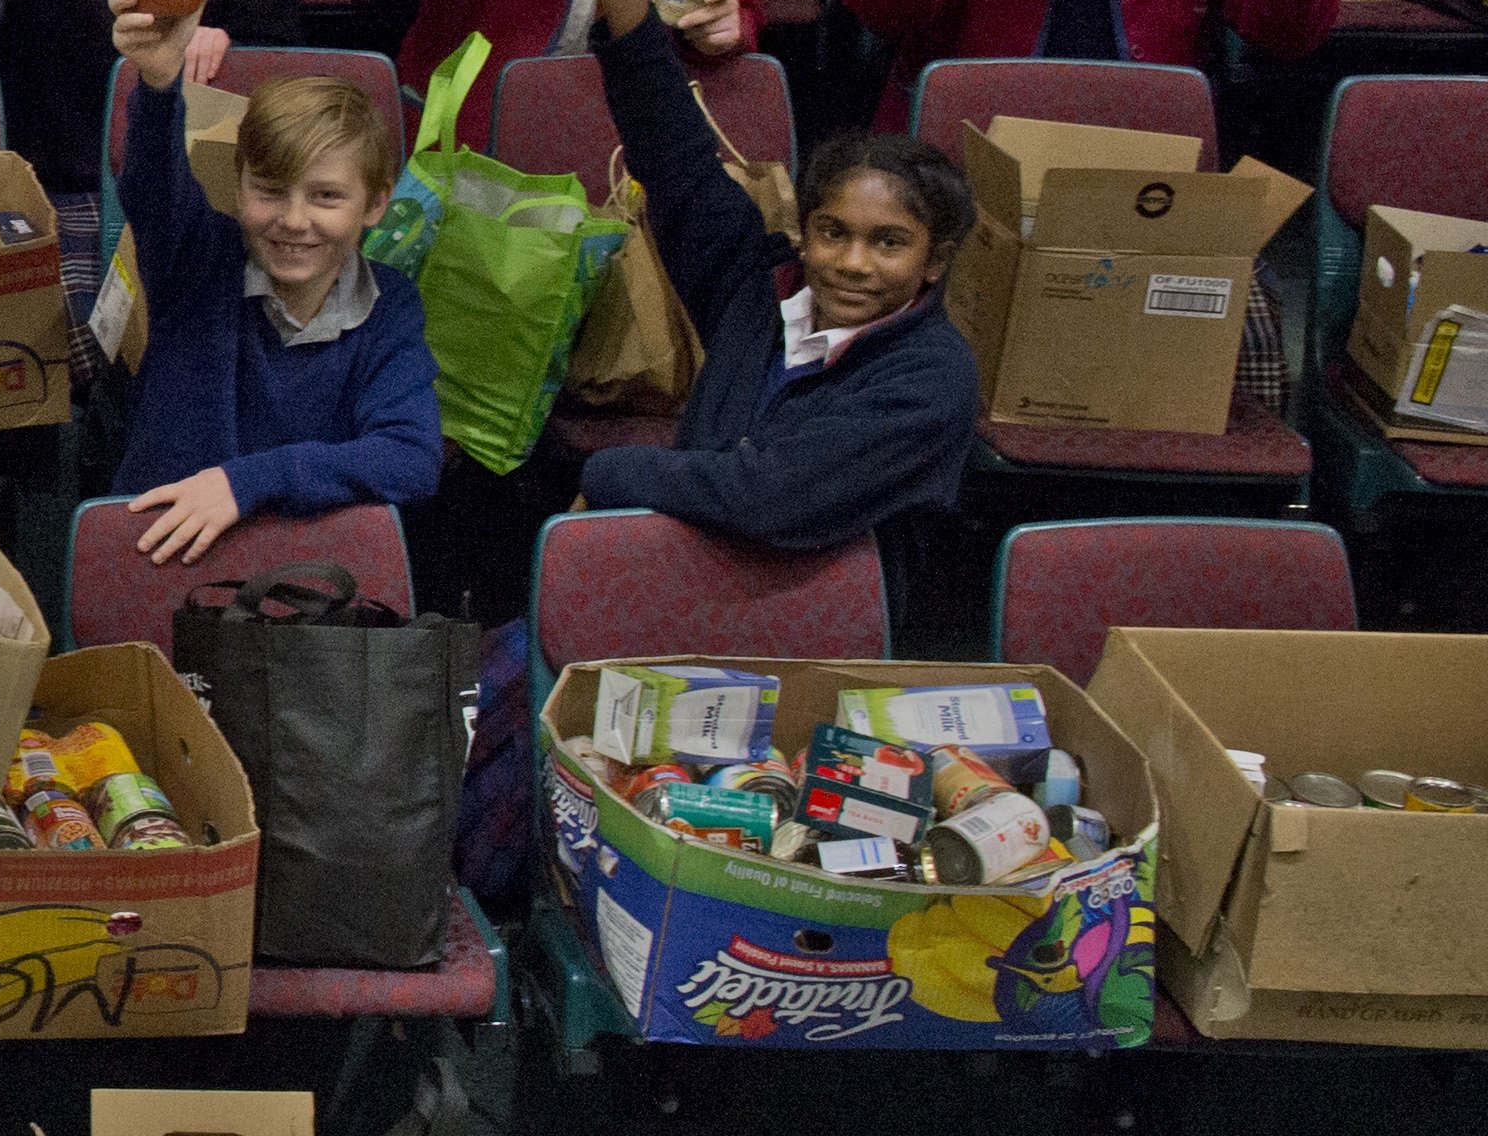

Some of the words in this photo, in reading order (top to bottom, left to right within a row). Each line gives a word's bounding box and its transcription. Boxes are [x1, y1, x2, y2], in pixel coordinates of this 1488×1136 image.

[702, 705, 715, 738] Milk
[711, 694, 726, 750] Standard
[937, 704, 955, 732] Milk
[949, 696, 970, 742] Standard
[724, 862, 773, 888] Quality
[774, 874, 788, 890] of
[790, 877, 823, 897] Fruit
[826, 885, 884, 907] Selected
[677, 958, 911, 1041] Frutadeli
